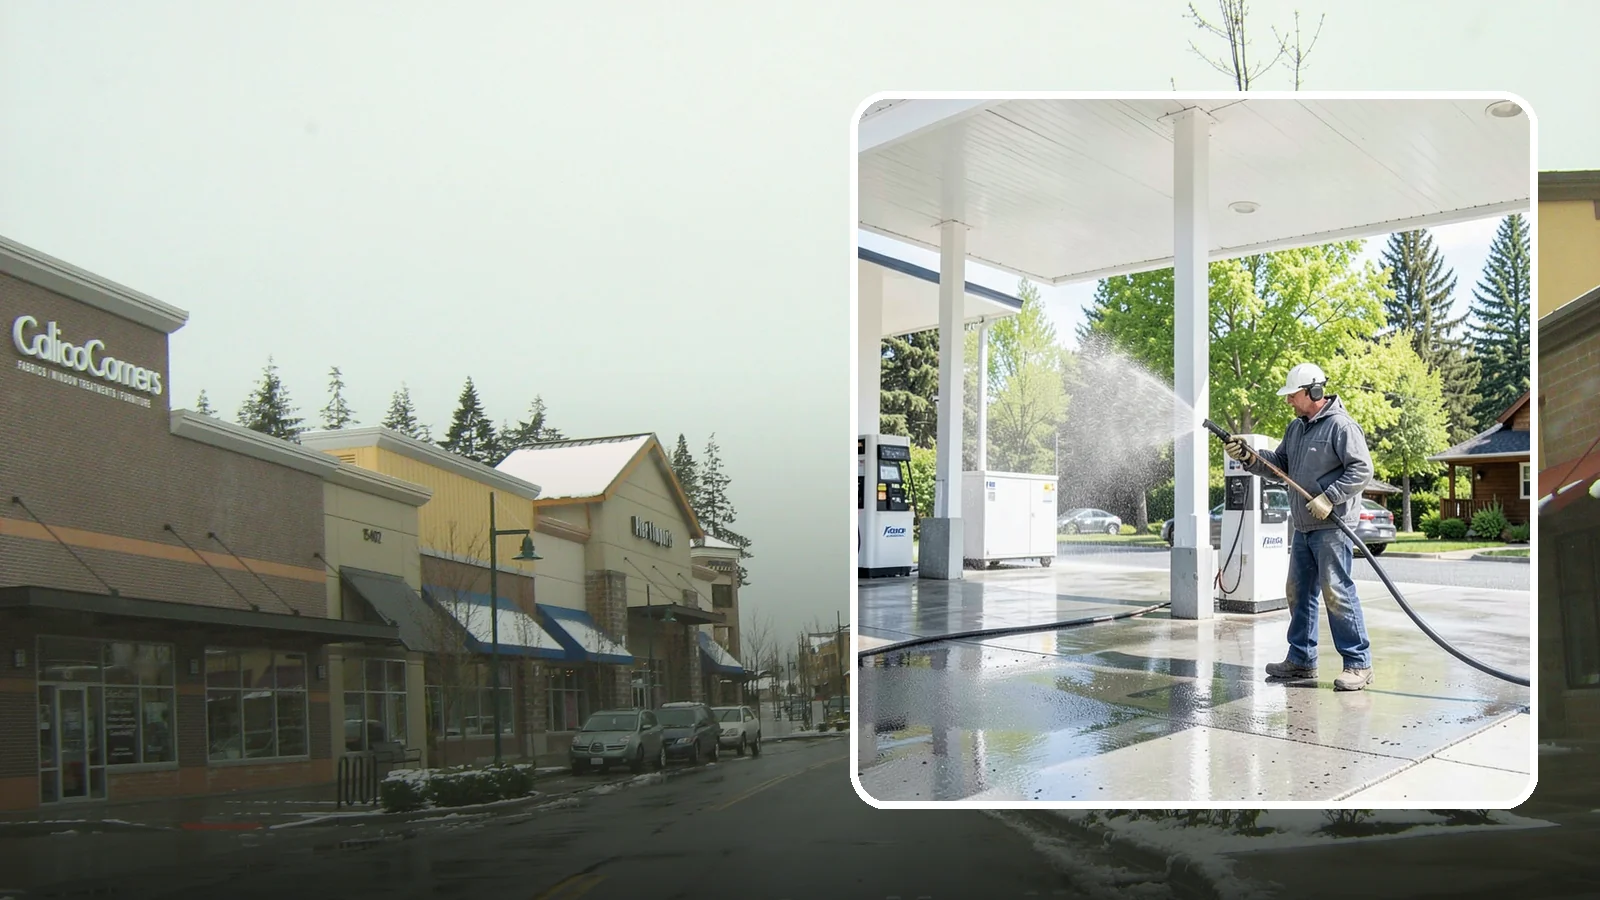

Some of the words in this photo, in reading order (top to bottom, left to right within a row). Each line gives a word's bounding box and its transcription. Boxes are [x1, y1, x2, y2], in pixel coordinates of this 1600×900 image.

[17, 360, 47, 378] FABRICS
[51, 370, 78, 387] WINDOW
[79, 378, 117, 398] TREATMENTS
[120, 391, 151, 408] FURNITURE
